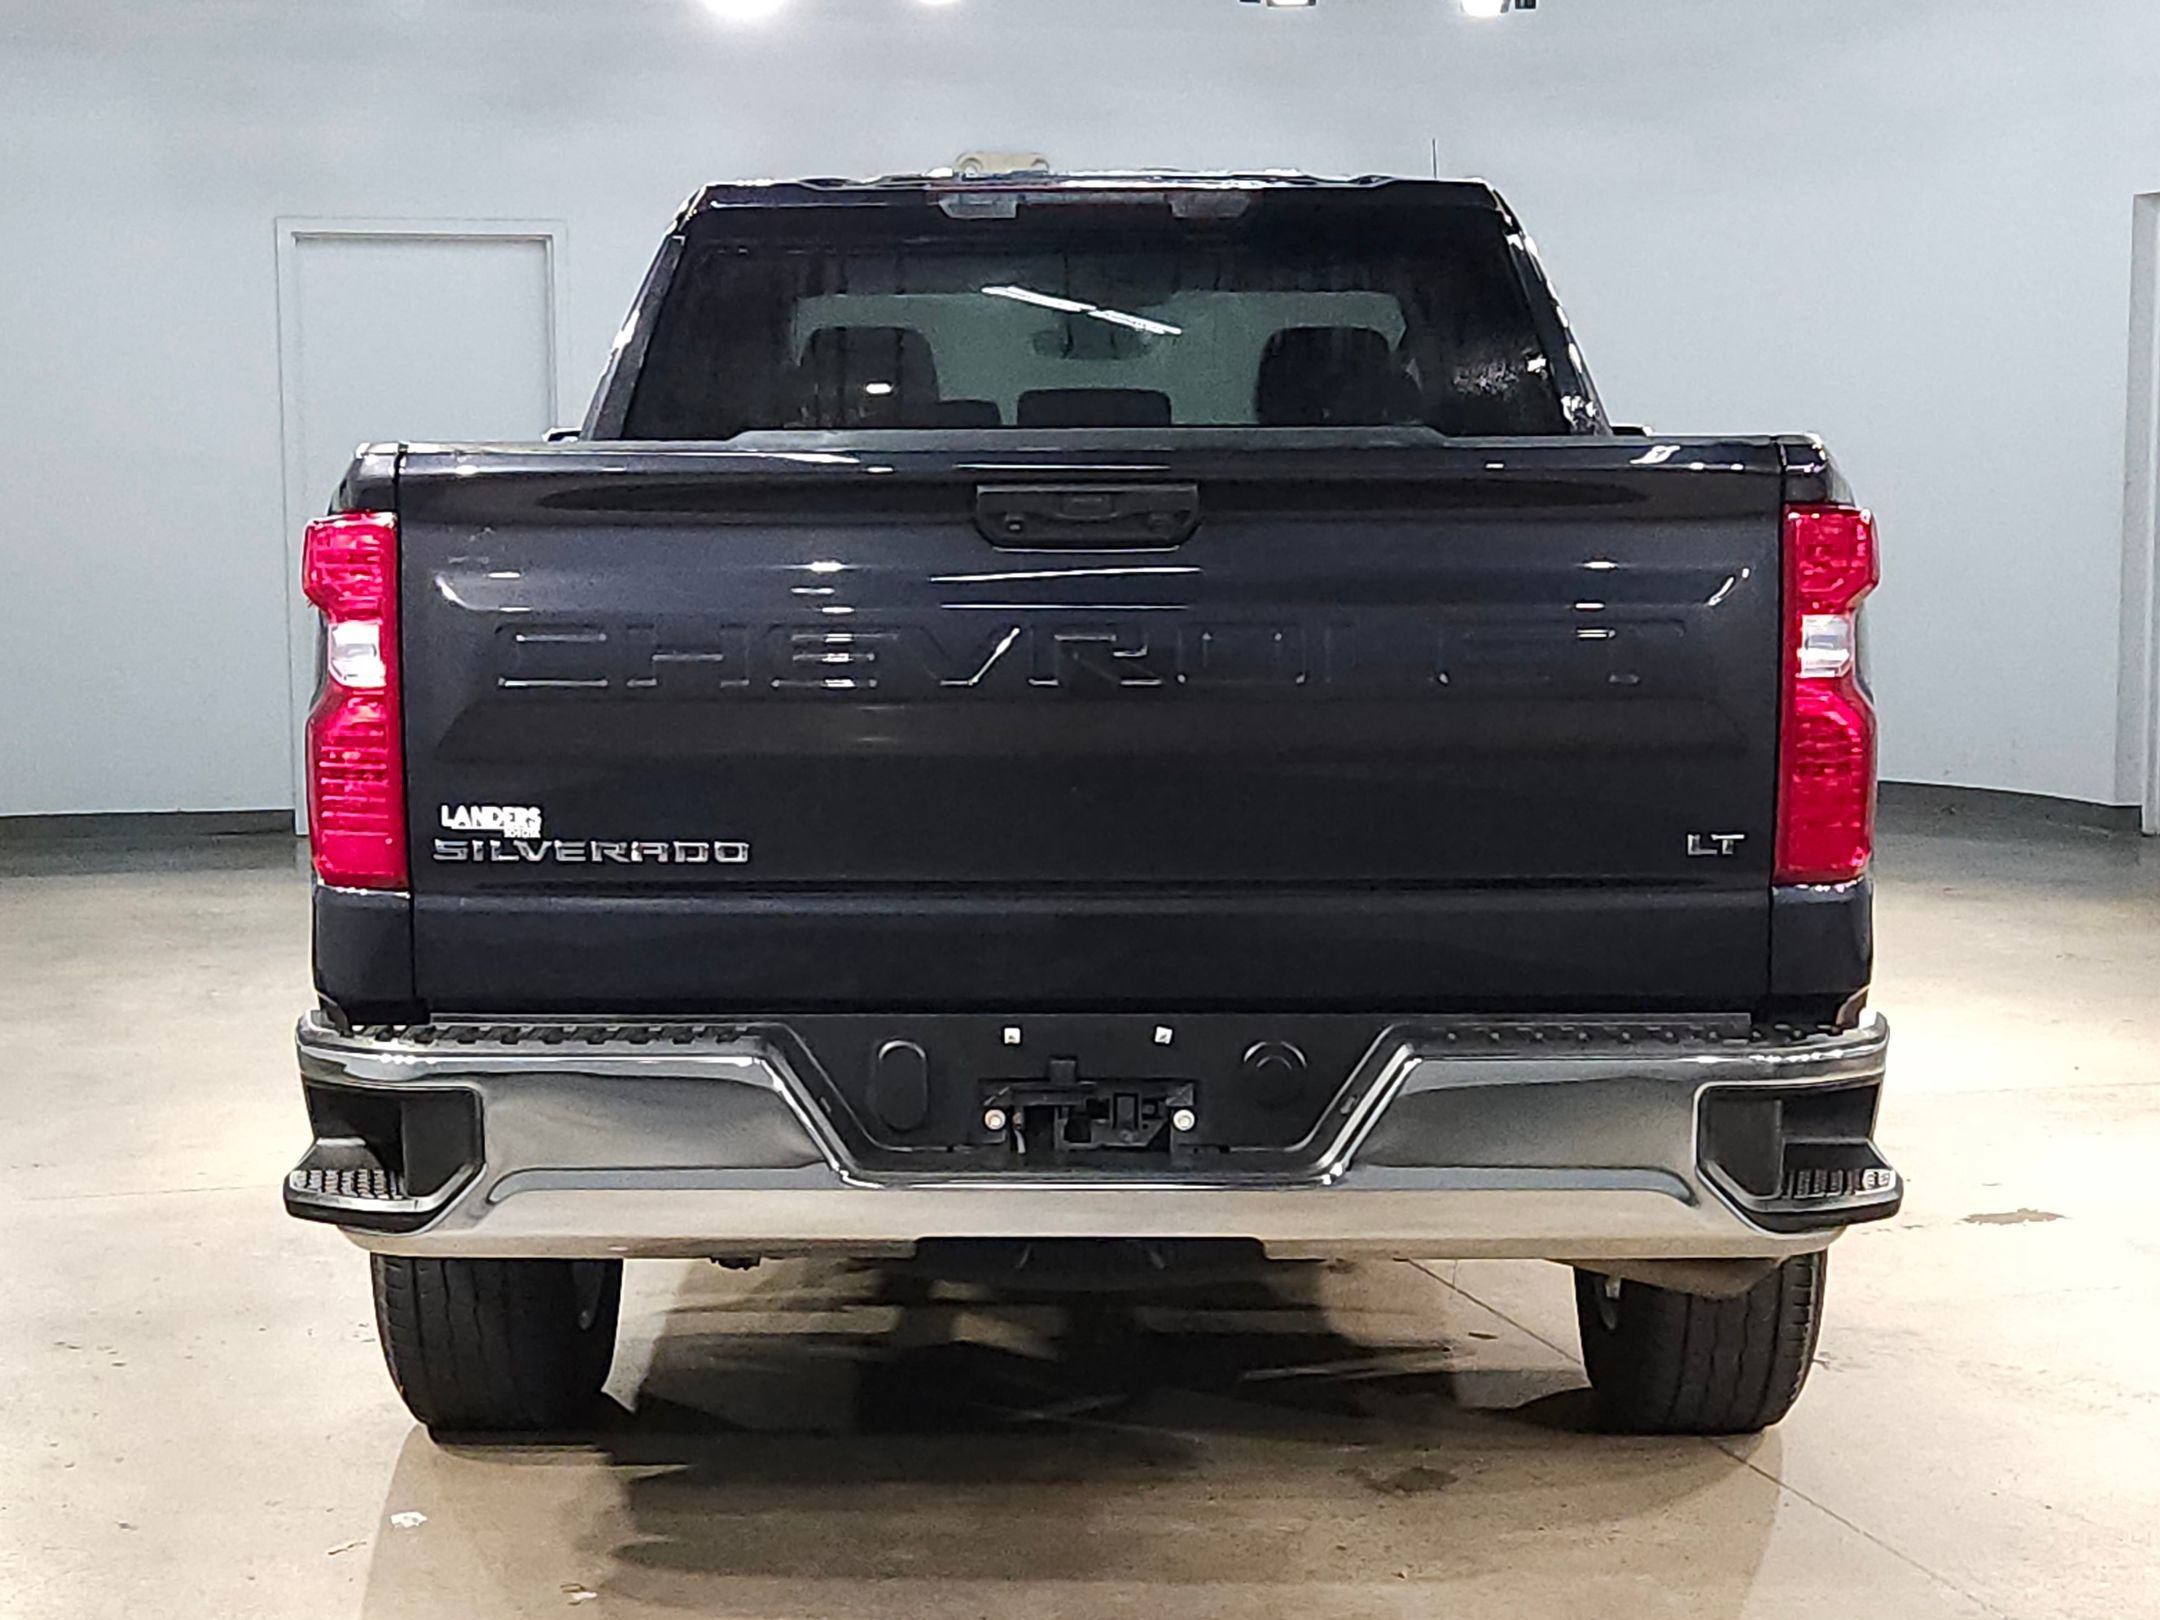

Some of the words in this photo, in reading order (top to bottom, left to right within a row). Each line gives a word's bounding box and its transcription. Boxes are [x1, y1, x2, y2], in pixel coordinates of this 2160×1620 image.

[441, 804, 541, 830] LANDERS
[433, 838, 749, 863] SILVERADO
[1687, 833, 1745, 855] LT
